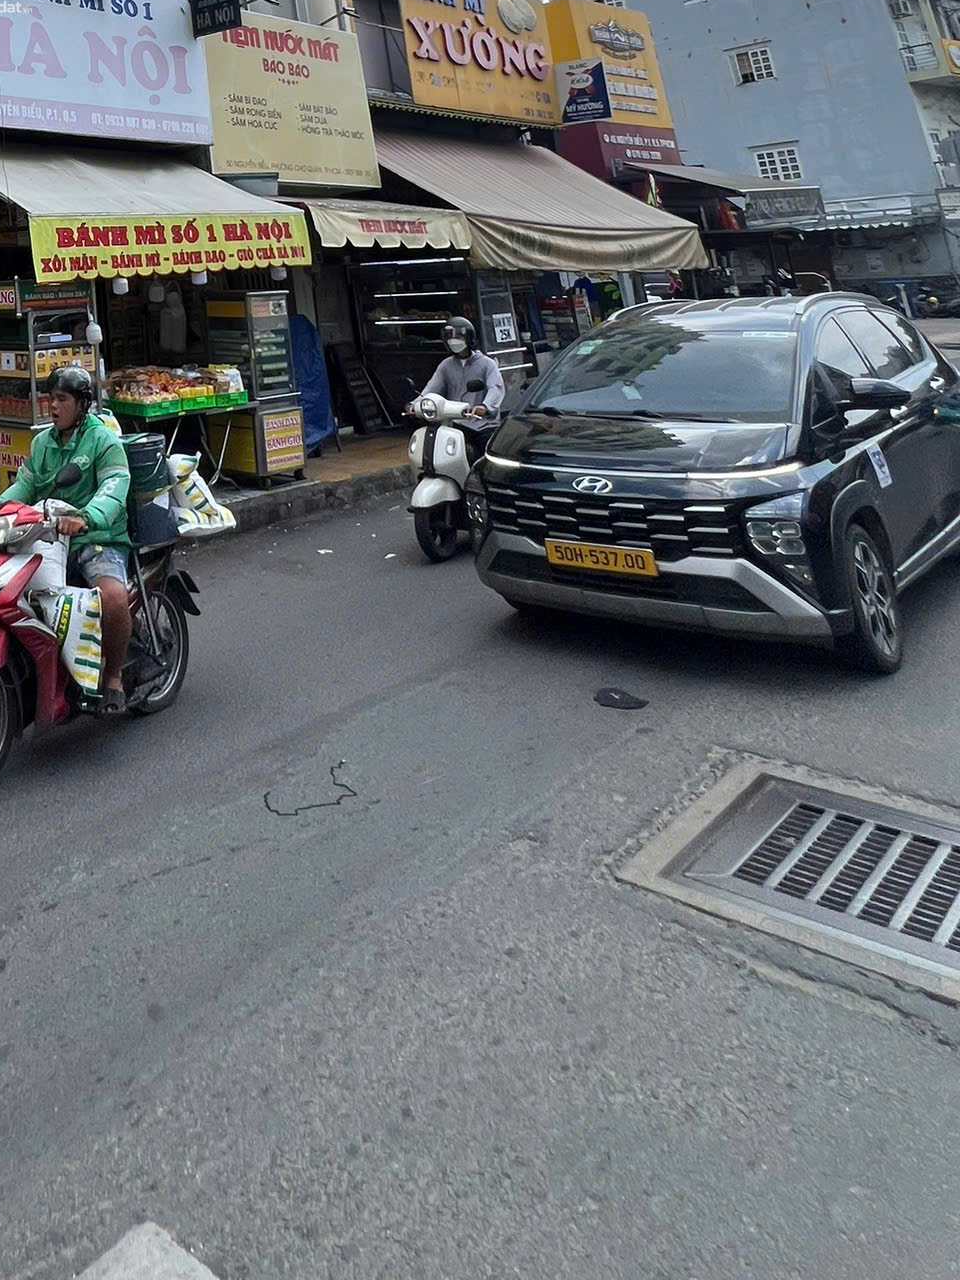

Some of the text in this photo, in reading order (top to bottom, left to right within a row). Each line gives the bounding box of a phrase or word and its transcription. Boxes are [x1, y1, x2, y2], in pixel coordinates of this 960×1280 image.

[214, 4, 235, 26] NỘI
[263, 29, 306, 57] NƯỚC
[307, 36, 340, 63] MÁT
[407, 14, 550, 82] XƯỜNG
[82, 25, 193, 106] NỘI
[55, 218, 292, 249] BÁNH MÌ SỐ 1 HÀ NỘI
[41, 254, 67, 273] XÔI
[69, 254, 98, 274] MẶN
[110, 250, 143, 269] BÁNH
[145, 249, 161, 269] MÌ
[172, 248, 203, 267] BÁNH
[205, 248, 226, 264] BAO
[236, 245, 254, 262] GIÒ
[255, 243, 276, 260] CHẢ
[276, 243, 290, 260] HÀ
[290, 244, 305, 260] NỘI
[553, 545, 646, 570] 50H-537.00
